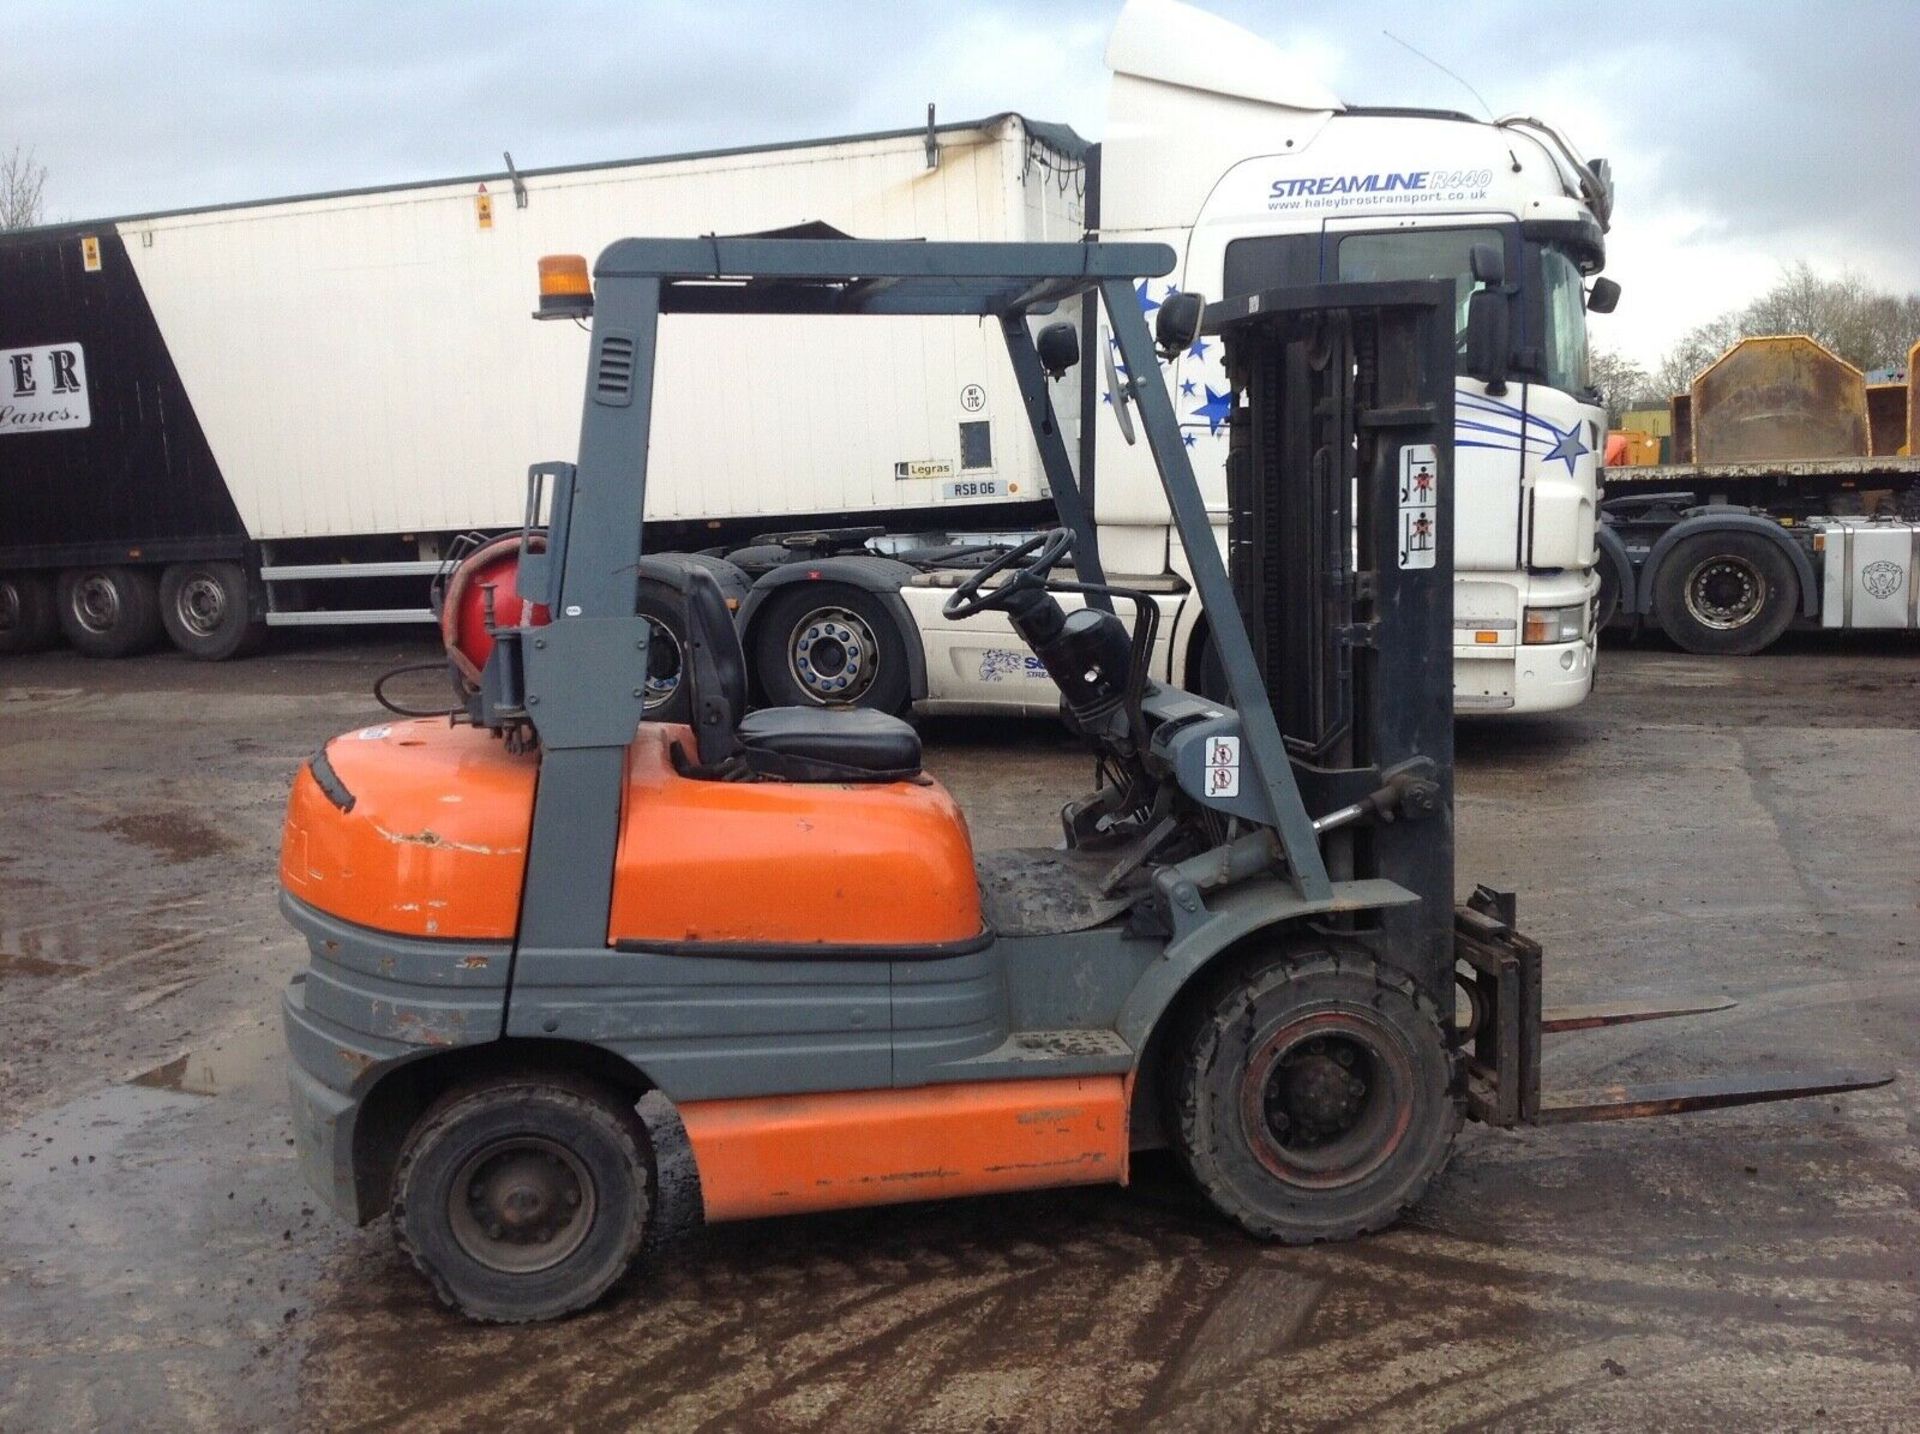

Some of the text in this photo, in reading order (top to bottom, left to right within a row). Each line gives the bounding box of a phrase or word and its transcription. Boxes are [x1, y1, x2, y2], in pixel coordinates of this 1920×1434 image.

[1269, 168, 1494, 199] STREAMLINE R440
[1268, 189, 1488, 210] www.haleybrostransport.co.uk
[911, 463, 950, 475] Legras
[954, 482, 995, 496] RSB 06
